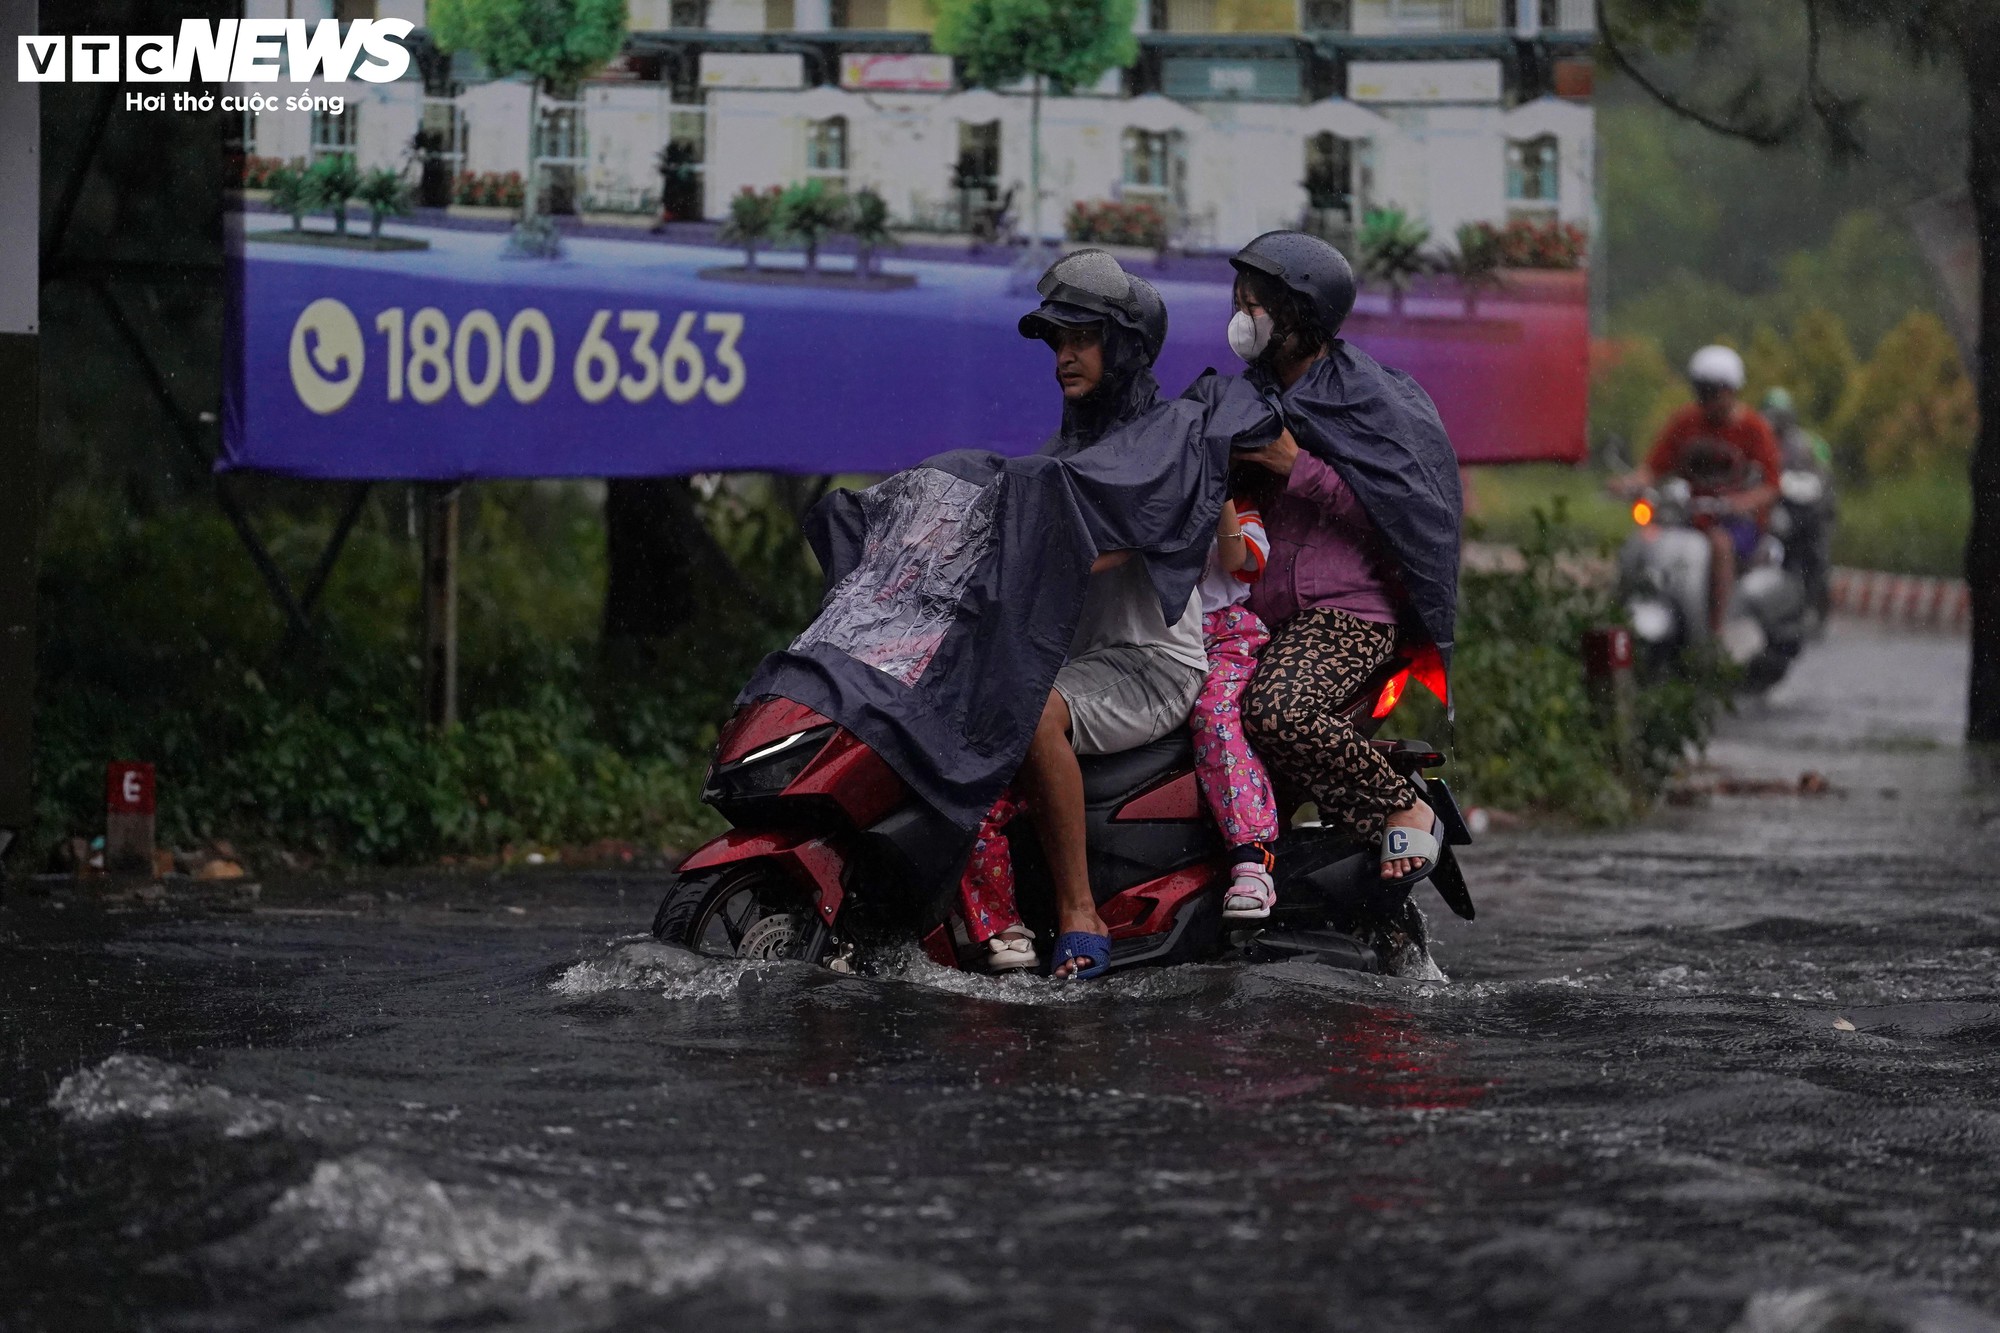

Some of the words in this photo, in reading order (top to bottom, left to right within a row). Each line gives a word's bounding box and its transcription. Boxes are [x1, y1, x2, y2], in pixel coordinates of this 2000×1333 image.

[375, 307, 555, 407] 1800
[573, 309, 746, 404] 6363
[1388, 830, 1409, 855] G
